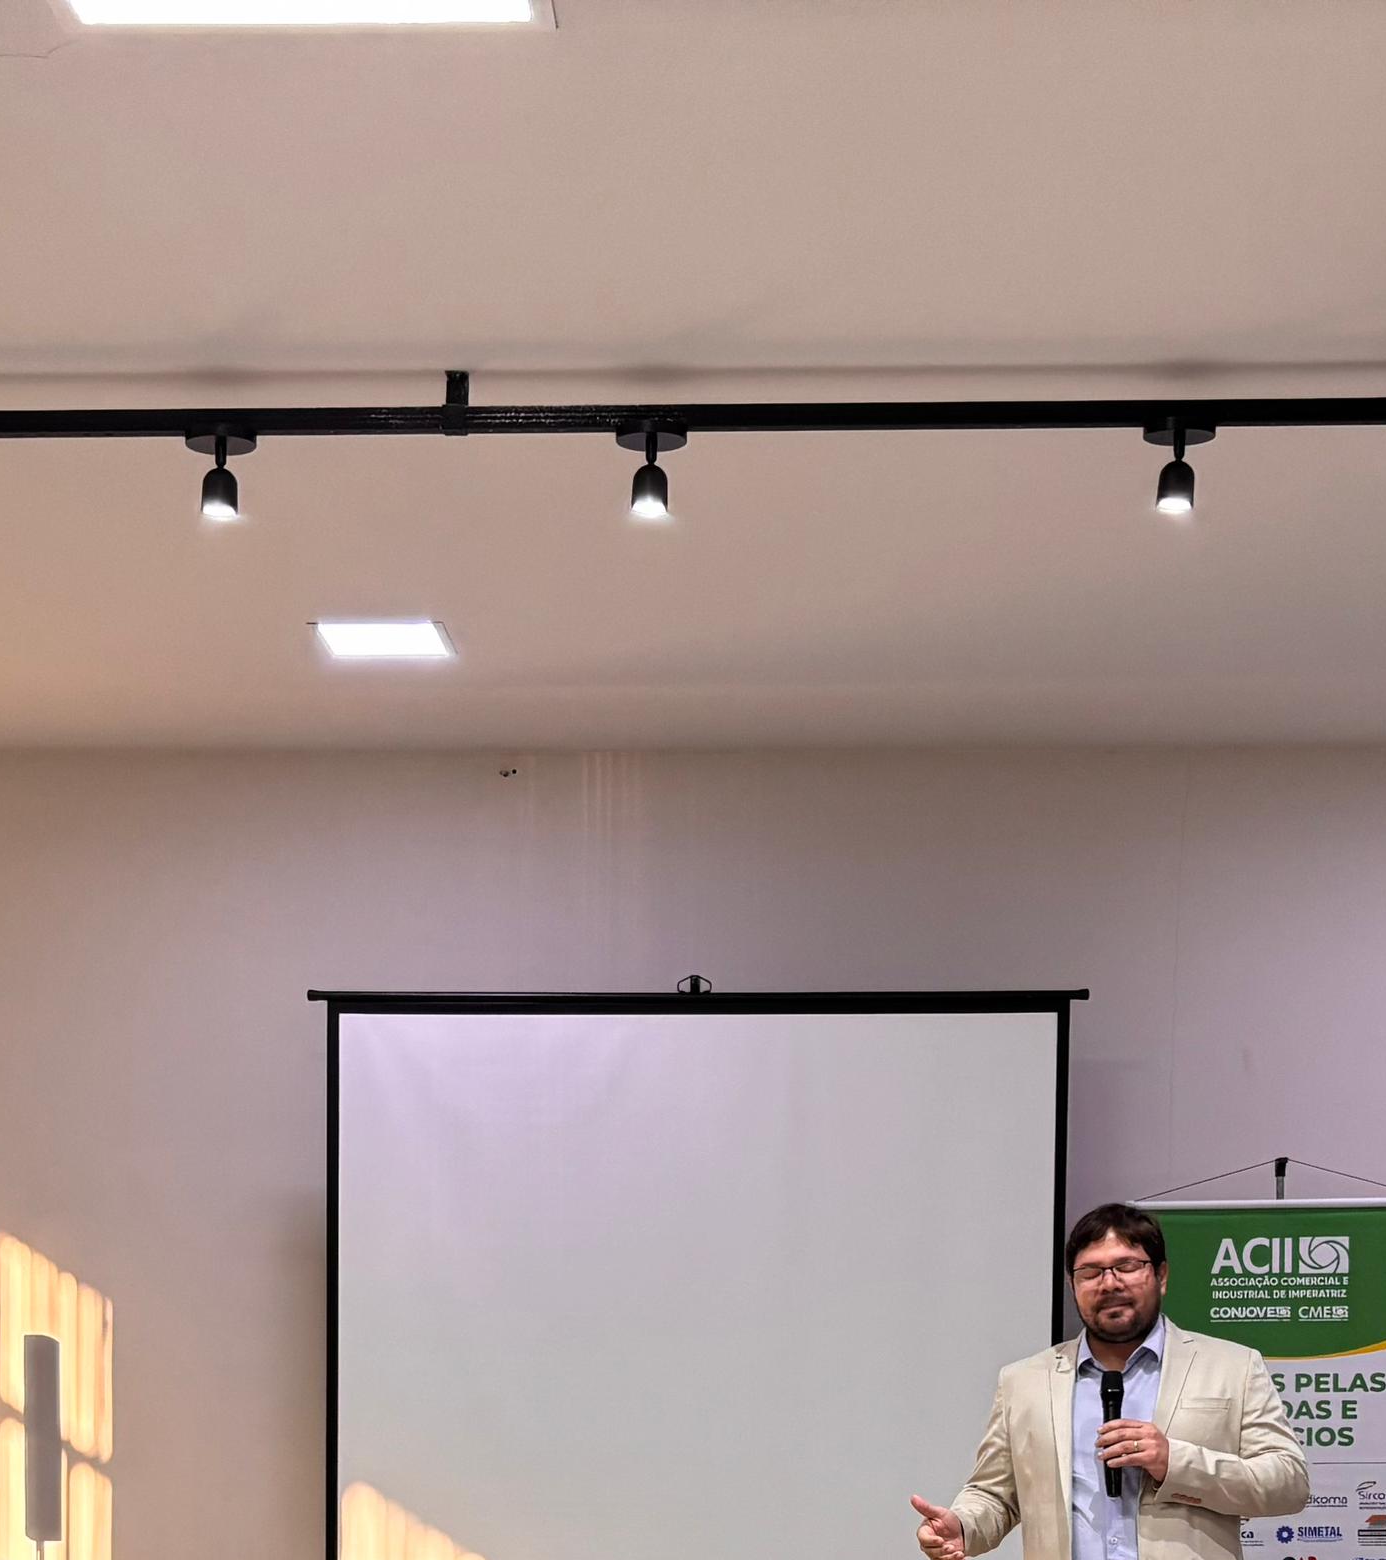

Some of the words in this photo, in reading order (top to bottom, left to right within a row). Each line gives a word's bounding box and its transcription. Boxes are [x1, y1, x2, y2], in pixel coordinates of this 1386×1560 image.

[1211, 1237, 1293, 1274] ACII
[1210, 1275, 1278, 1288] ASSOCIAÇÃO
[1281, 1276, 1340, 1286] COMERCIAL
[1342, 1276, 1349, 1285] E
[1212, 1290, 1271, 1299] INDUSTRIAL
[1273, 1290, 1286, 1299] DE
[1289, 1289, 1347, 1298] IMPERATRIZ
[1295, 1372, 1386, 1393] PELAS
[1341, 1400, 1358, 1419] E
[1297, 1526, 1342, 1538] SIMETAL
